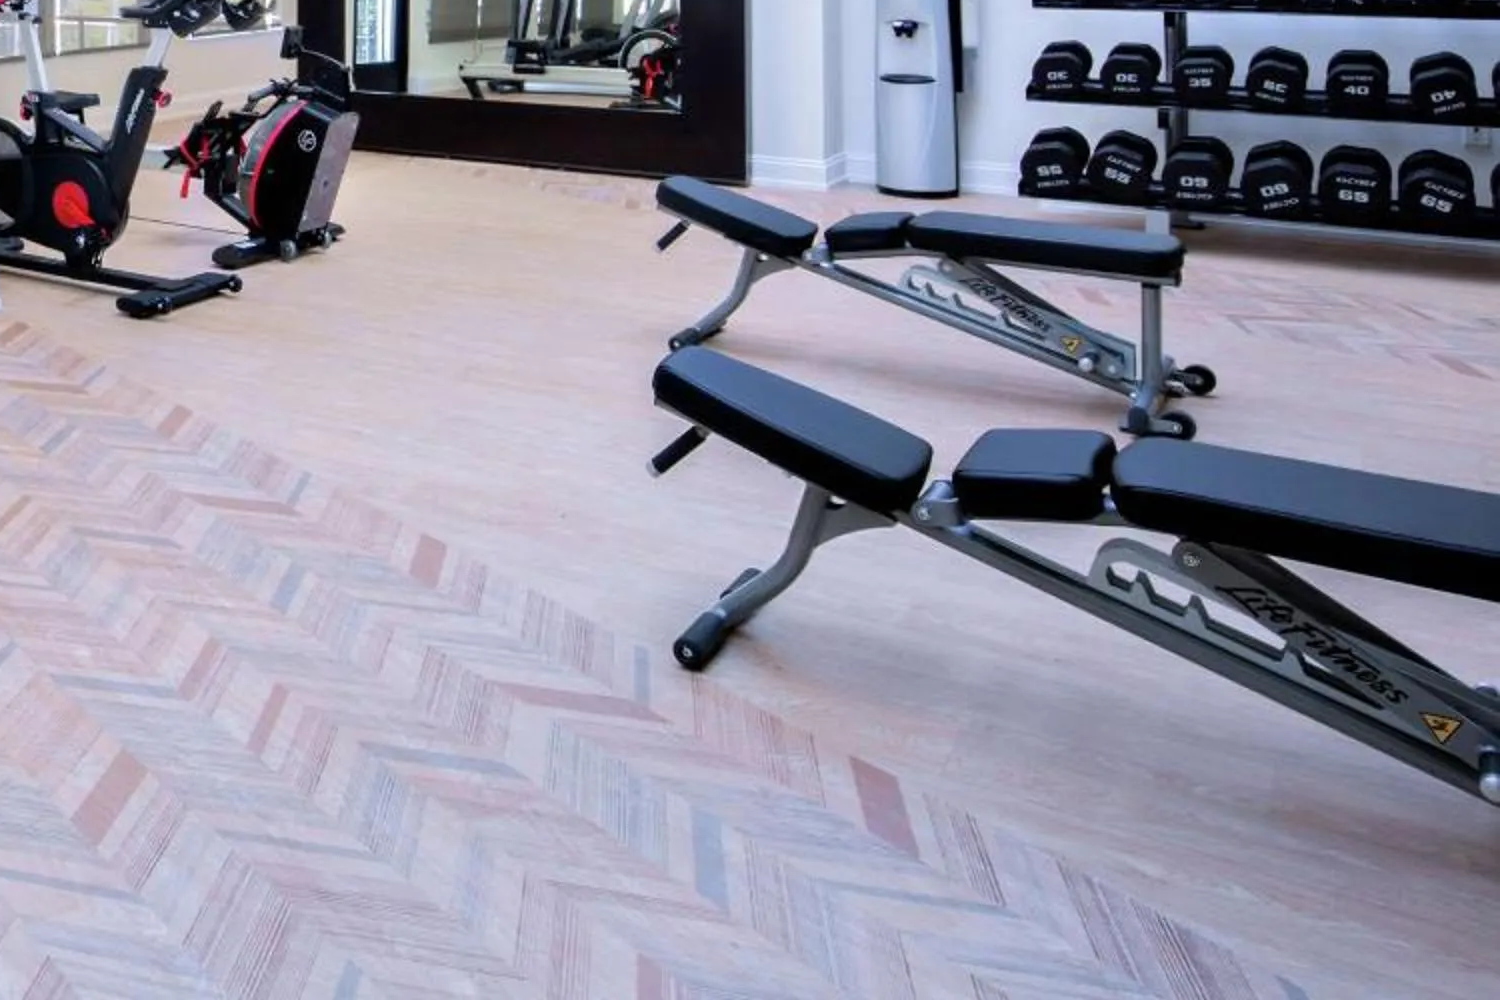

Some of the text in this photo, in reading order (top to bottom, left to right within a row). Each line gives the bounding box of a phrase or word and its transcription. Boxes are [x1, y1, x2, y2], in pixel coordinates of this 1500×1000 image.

[1343, 84, 1370, 96] 40
[1430, 89, 1456, 104] 40
[1419, 193, 1453, 213] 65
